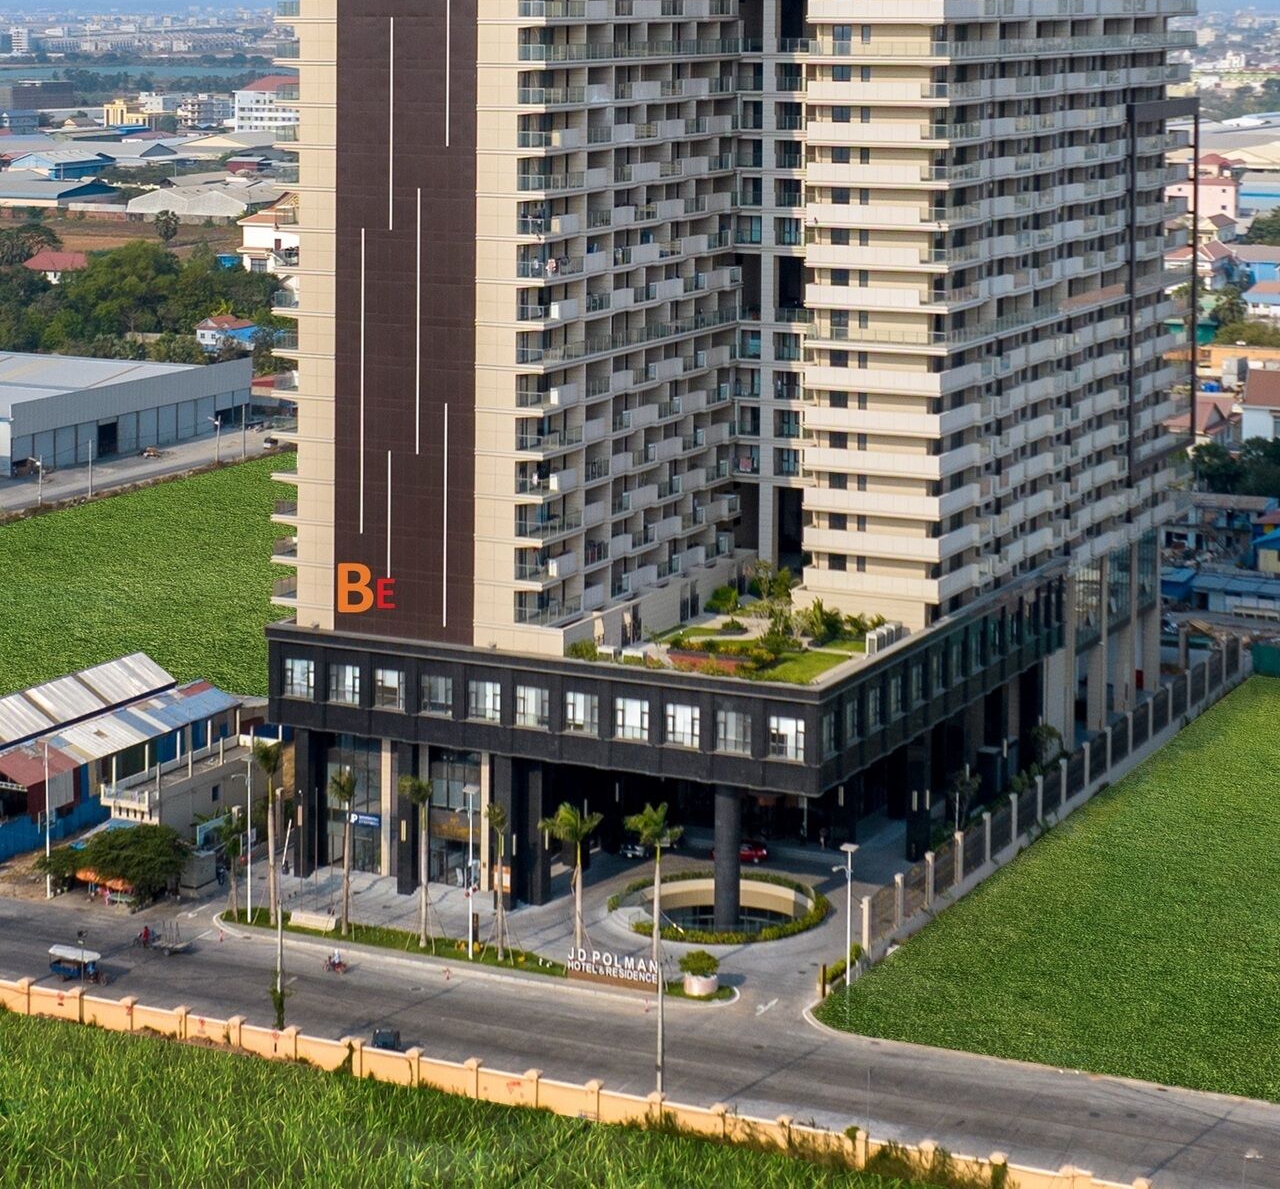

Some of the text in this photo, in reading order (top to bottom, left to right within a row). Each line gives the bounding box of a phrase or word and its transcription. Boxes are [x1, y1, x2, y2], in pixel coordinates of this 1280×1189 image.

[568, 960, 657, 984] HOTEL & RESIDENCE
[592, 951, 658, 973] POLMAN
